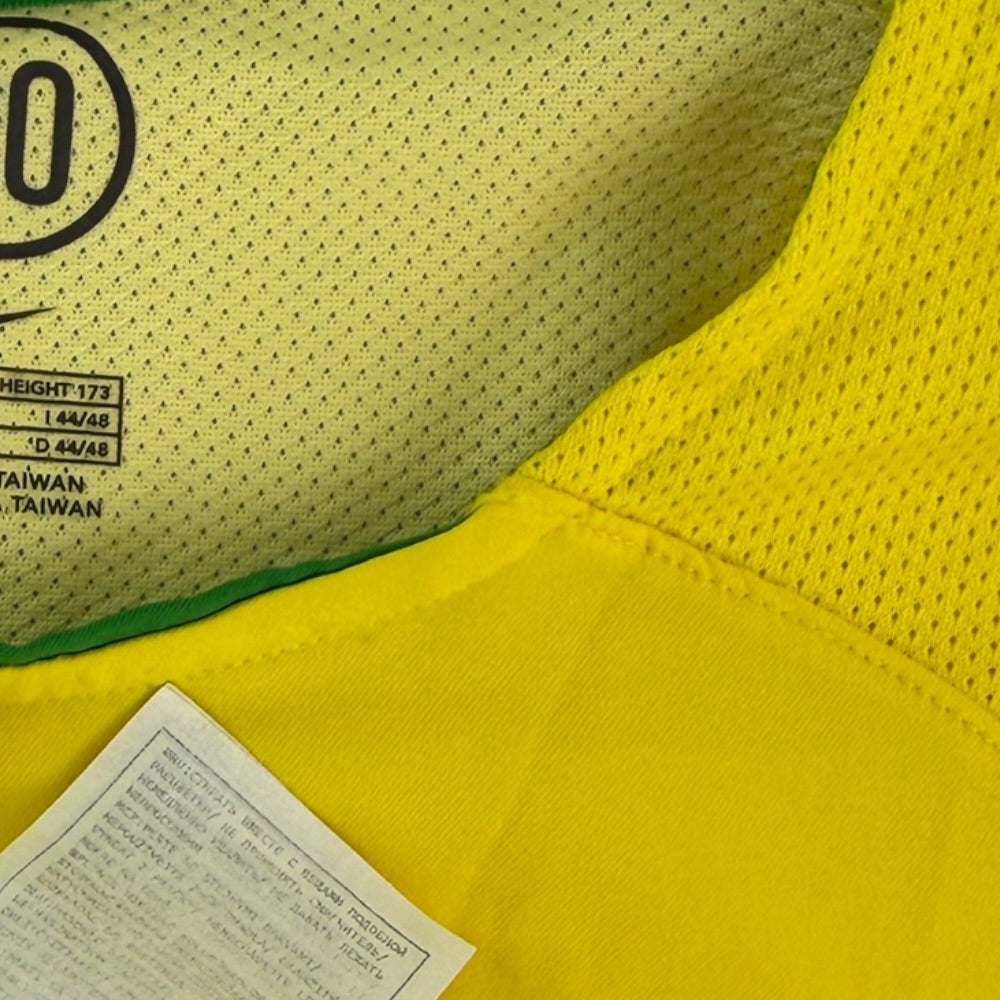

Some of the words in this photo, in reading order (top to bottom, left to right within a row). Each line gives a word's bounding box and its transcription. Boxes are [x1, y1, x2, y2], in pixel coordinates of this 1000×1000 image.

[0, 377, 72, 398] HEIGHT
[78, 383, 110, 400] 173
[45, 409, 51, 426] I
[55, 410, 110, 429] 44/48
[35, 437, 50, 454] D
[55, 438, 110, 458] 44/48
[9, 495, 102, 518] TAIWAN
